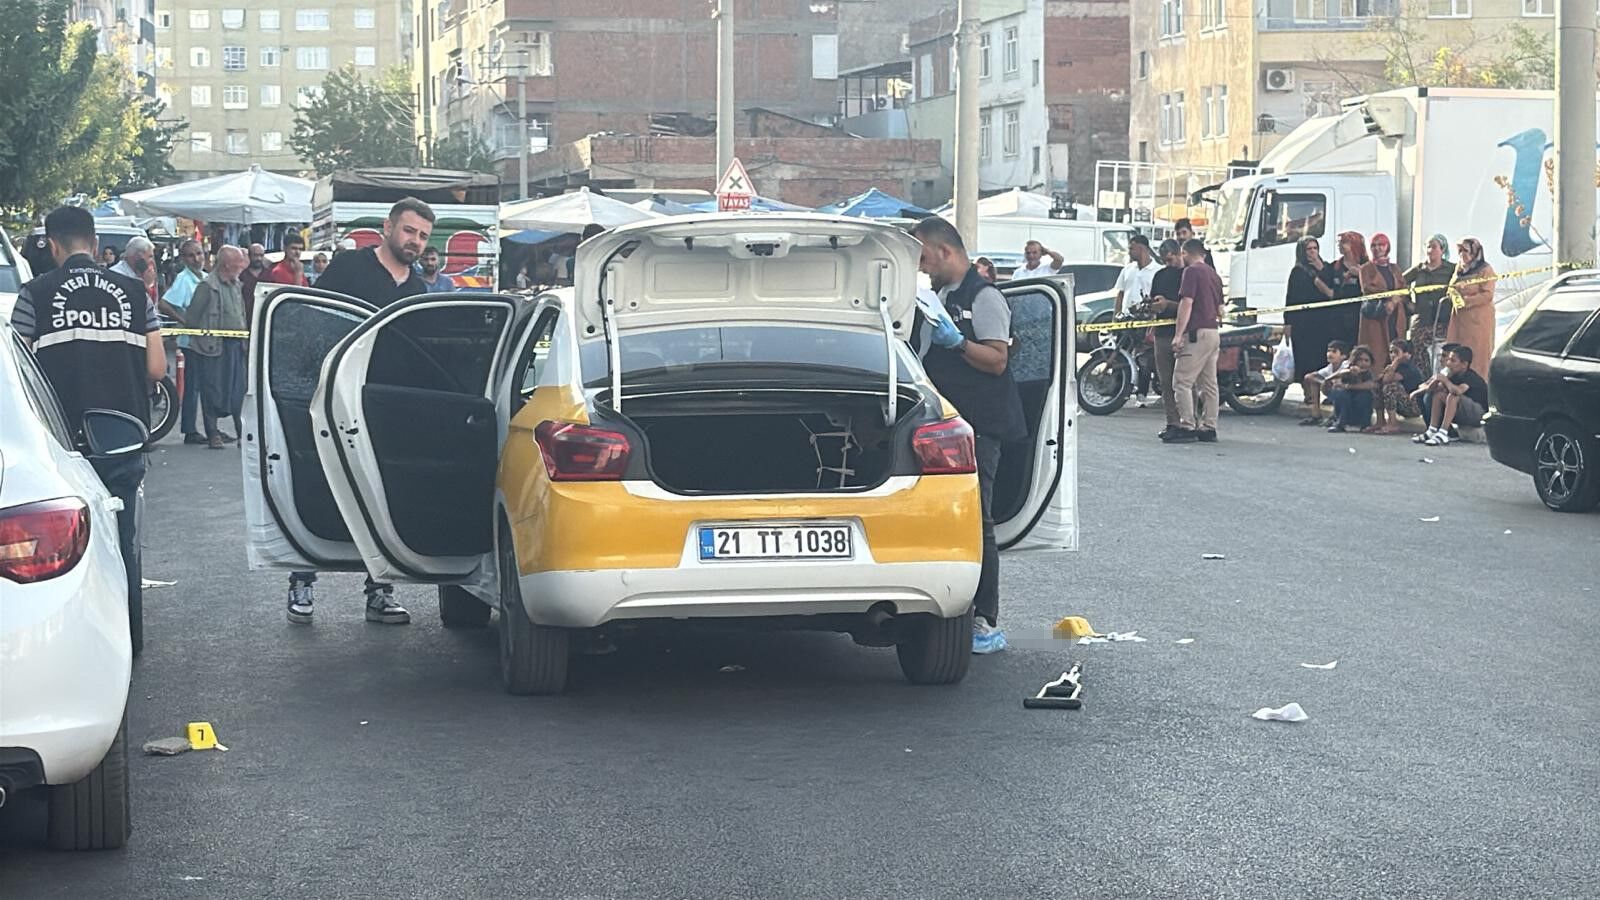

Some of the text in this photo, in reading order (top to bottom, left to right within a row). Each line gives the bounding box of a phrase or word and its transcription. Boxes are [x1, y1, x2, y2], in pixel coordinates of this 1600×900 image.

[52, 292, 67, 328] OLAY
[703, 546, 714, 555] TR
[717, 530, 846, 554] 21 TT 1038
